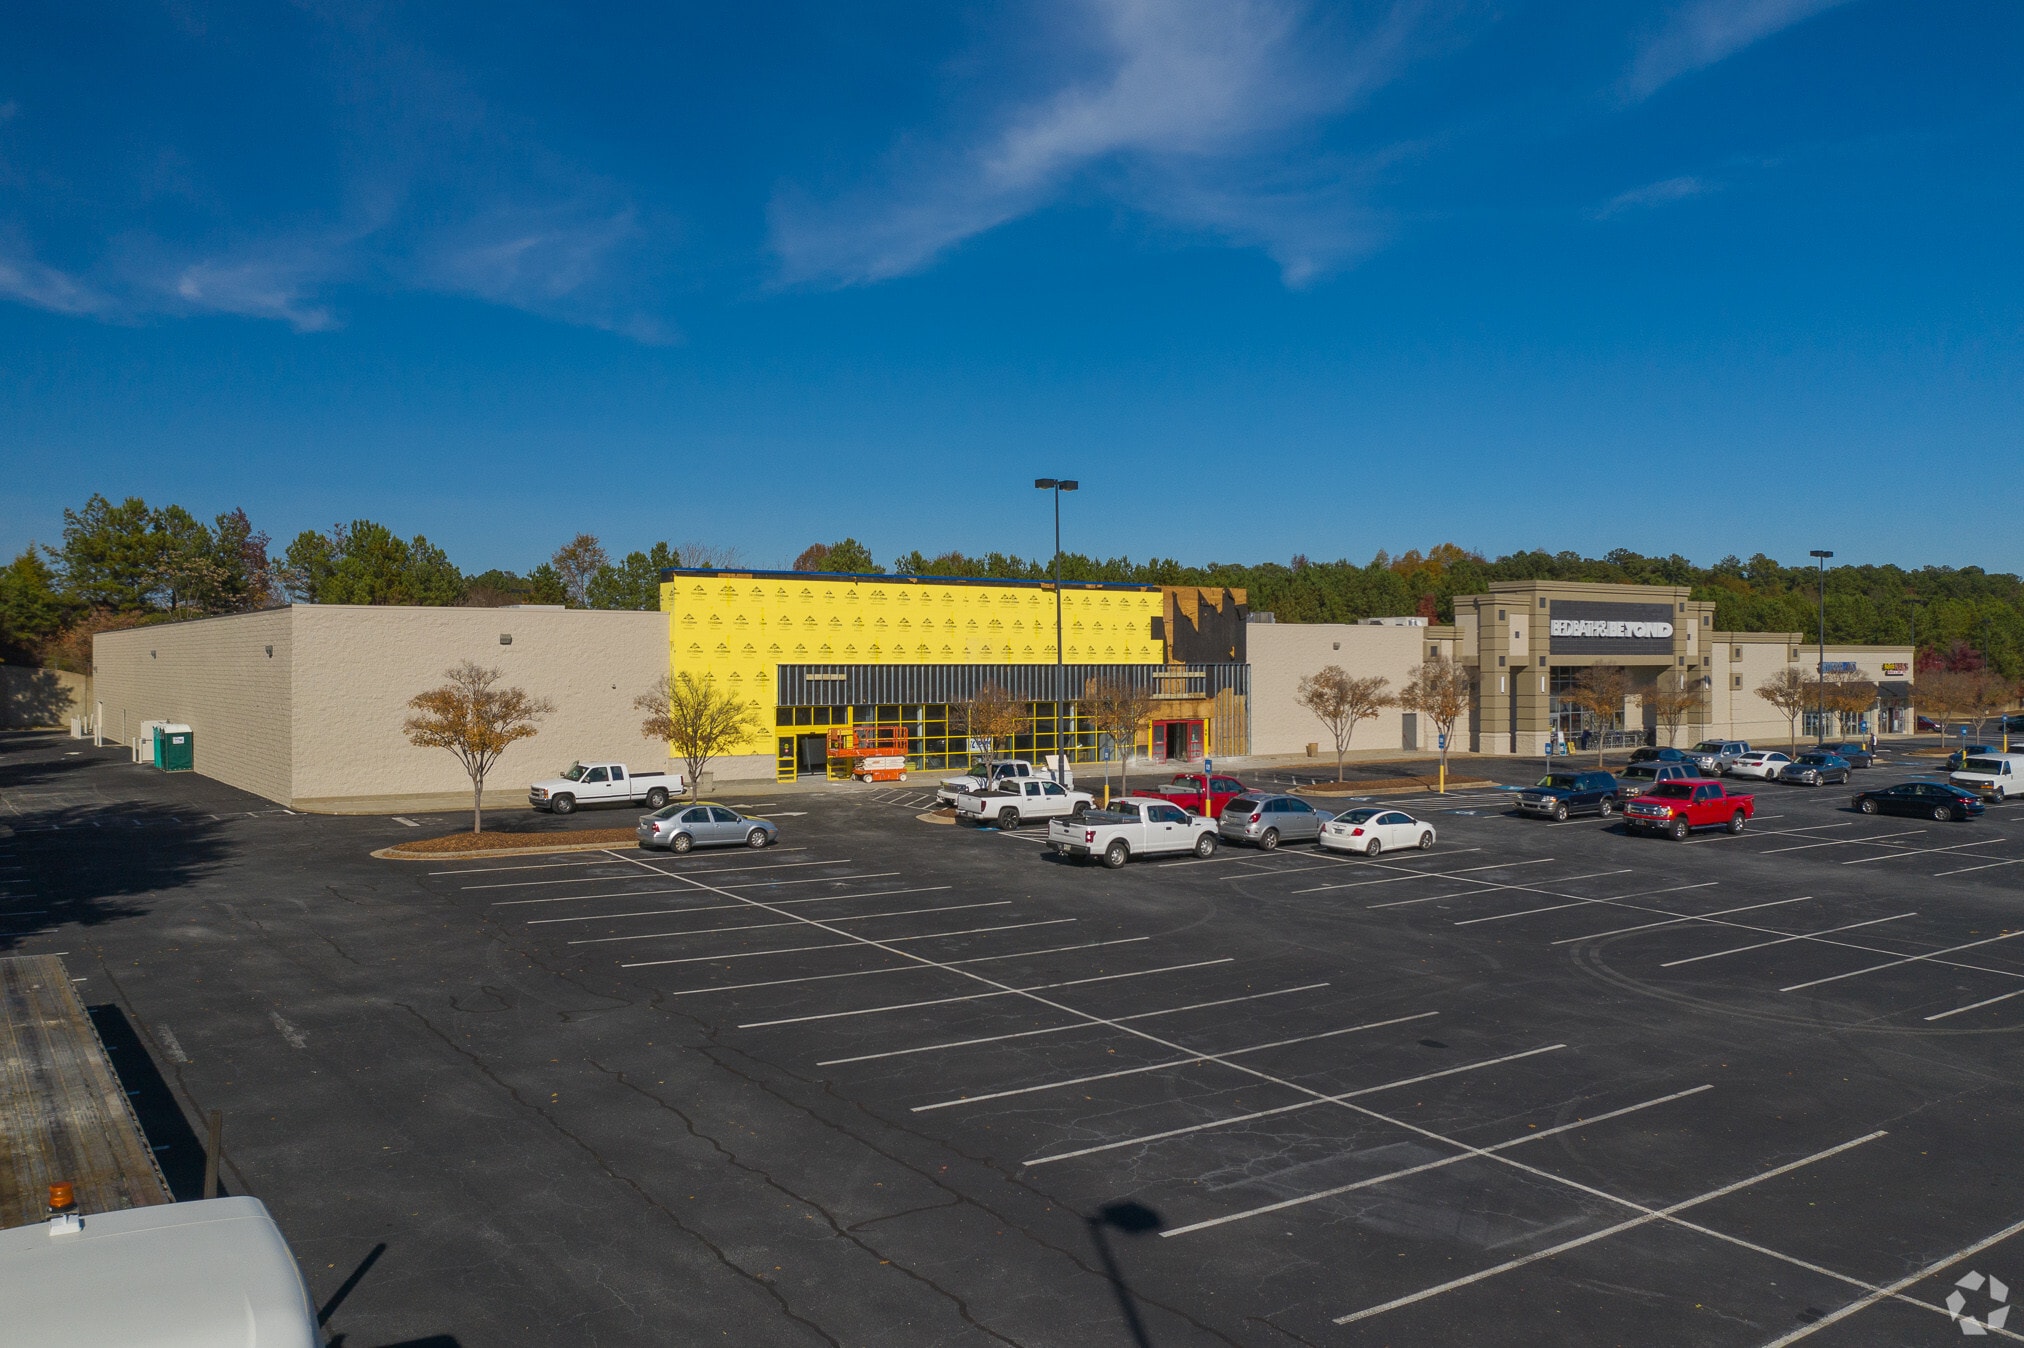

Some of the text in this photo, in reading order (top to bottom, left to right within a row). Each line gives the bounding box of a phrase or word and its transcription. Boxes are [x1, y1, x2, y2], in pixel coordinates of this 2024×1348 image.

[1550, 619, 1674, 638] BED BATH & BEYOND
